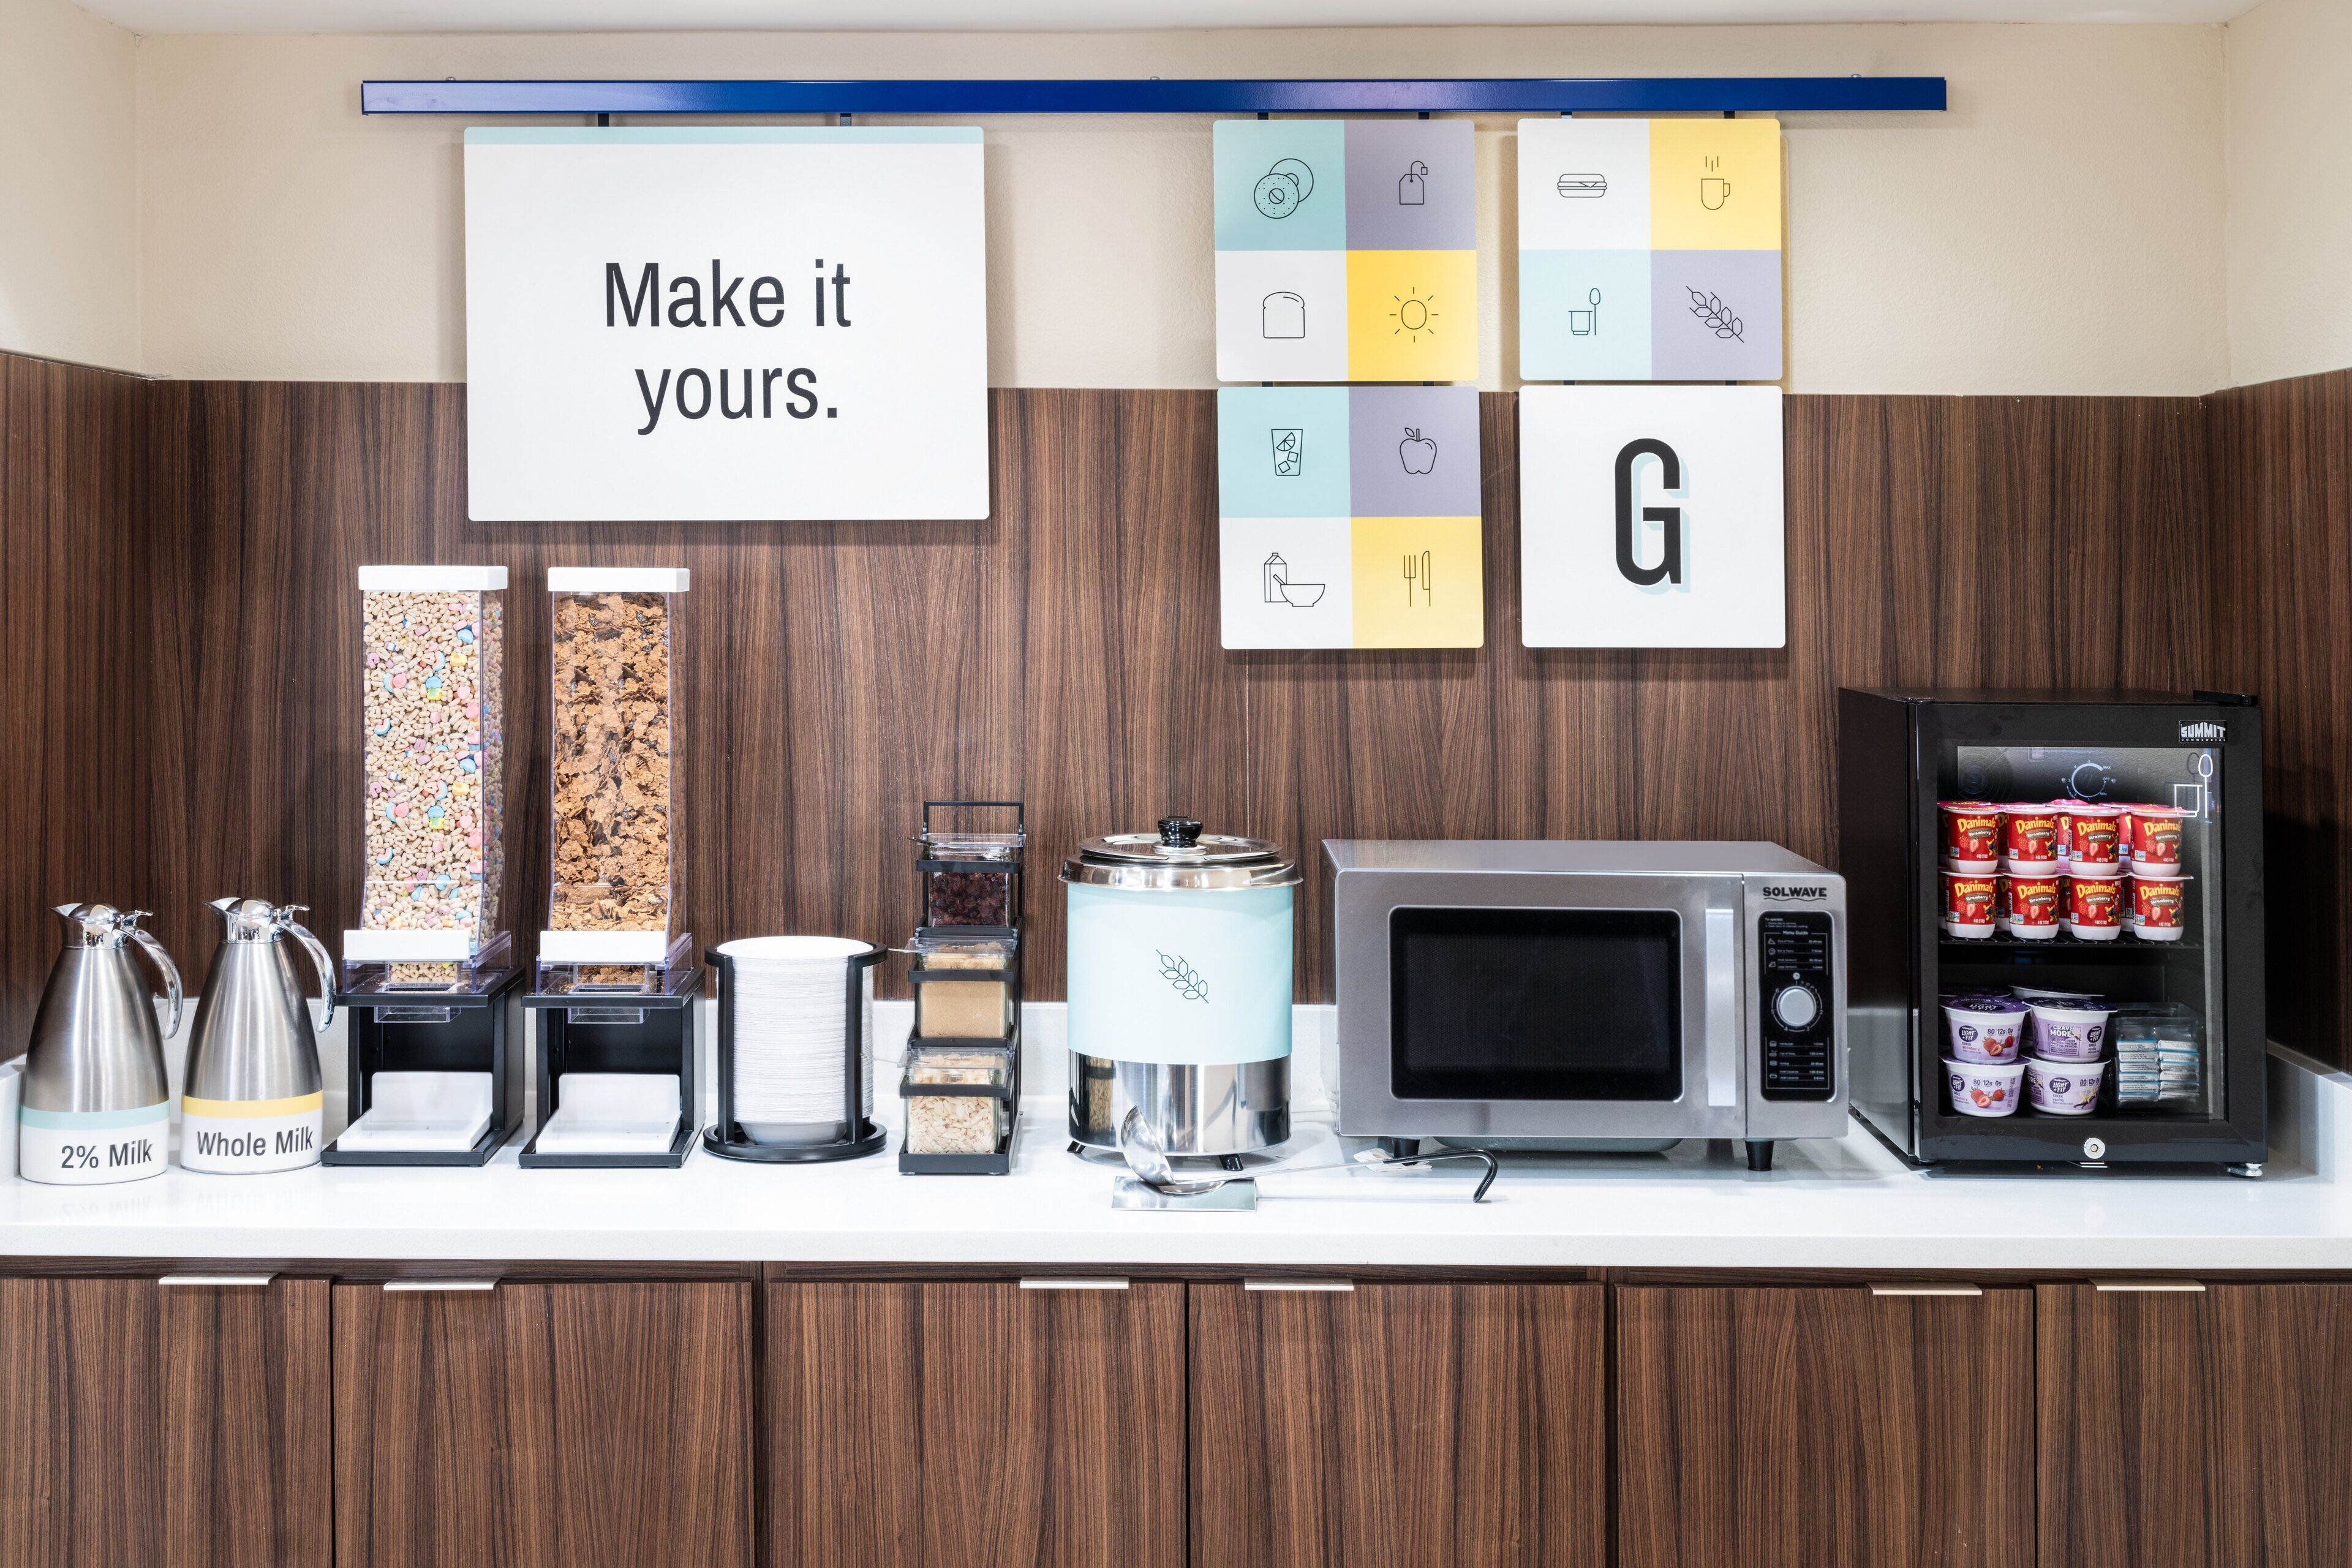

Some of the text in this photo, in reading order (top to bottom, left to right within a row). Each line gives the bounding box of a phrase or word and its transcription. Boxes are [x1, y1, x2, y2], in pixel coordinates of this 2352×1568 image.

[605, 258, 851, 328] Make it
[635, 366, 838, 435] yours.
[1615, 437, 1686, 590] G
[2181, 722, 2226, 737] SUMMIT
[1957, 816, 1996, 832] Danimals
[2015, 816, 2054, 834] Danimals
[2077, 819, 2116, 836] Danimals
[2143, 820, 2181, 836] Danimals
[1763, 886, 1827, 897] SOLWAVE
[1954, 880, 1994, 897] Danimals
[2017, 882, 2056, 900] Danimals
[2076, 881, 2116, 899] Danimals
[2139, 883, 2180, 900] Danimals
[196, 1125, 314, 1158] Whole Milk
[61, 1139, 153, 1169] 2% Milk
